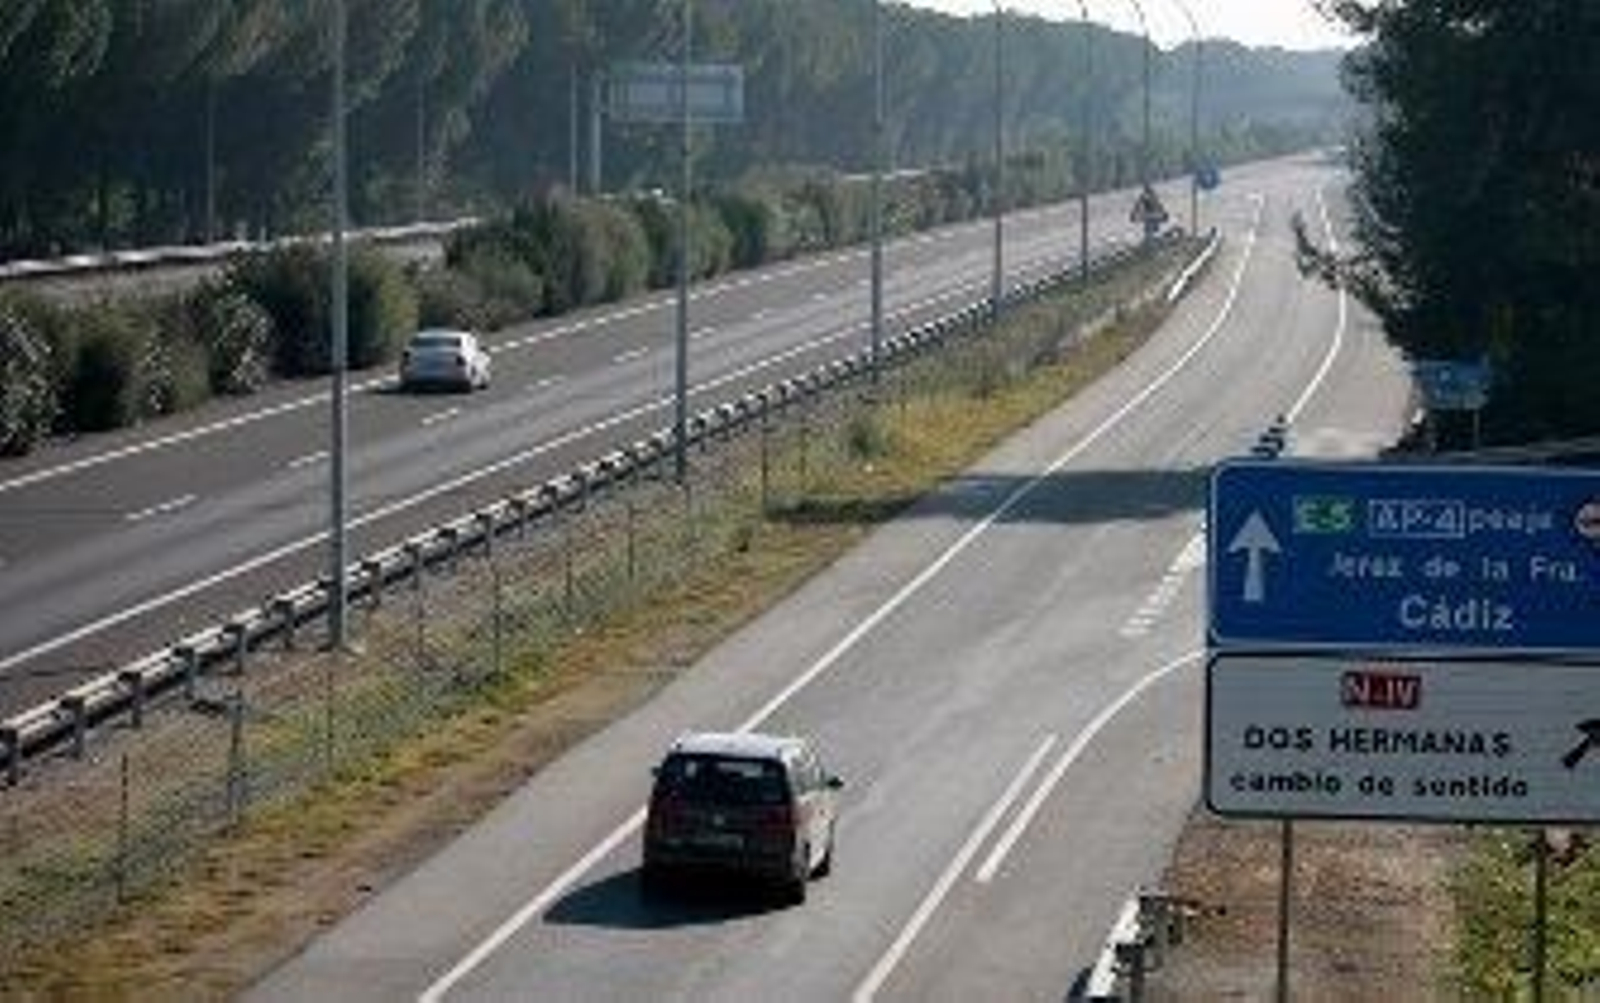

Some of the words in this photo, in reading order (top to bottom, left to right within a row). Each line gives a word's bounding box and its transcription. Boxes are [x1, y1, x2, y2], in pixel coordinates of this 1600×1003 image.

[1301, 501, 1351, 531] E-5
[1375, 502, 1457, 531] AP-4
[1424, 554, 1461, 578] de
[1483, 556, 1509, 580] la
[1400, 595, 1514, 631] Cádiz
[1244, 726, 1313, 750] DOS
[1330, 728, 1511, 757] HERMANAS
[1229, 771, 1342, 797] cambio
[1359, 774, 1394, 797] de
[1413, 774, 1529, 798] sentido
